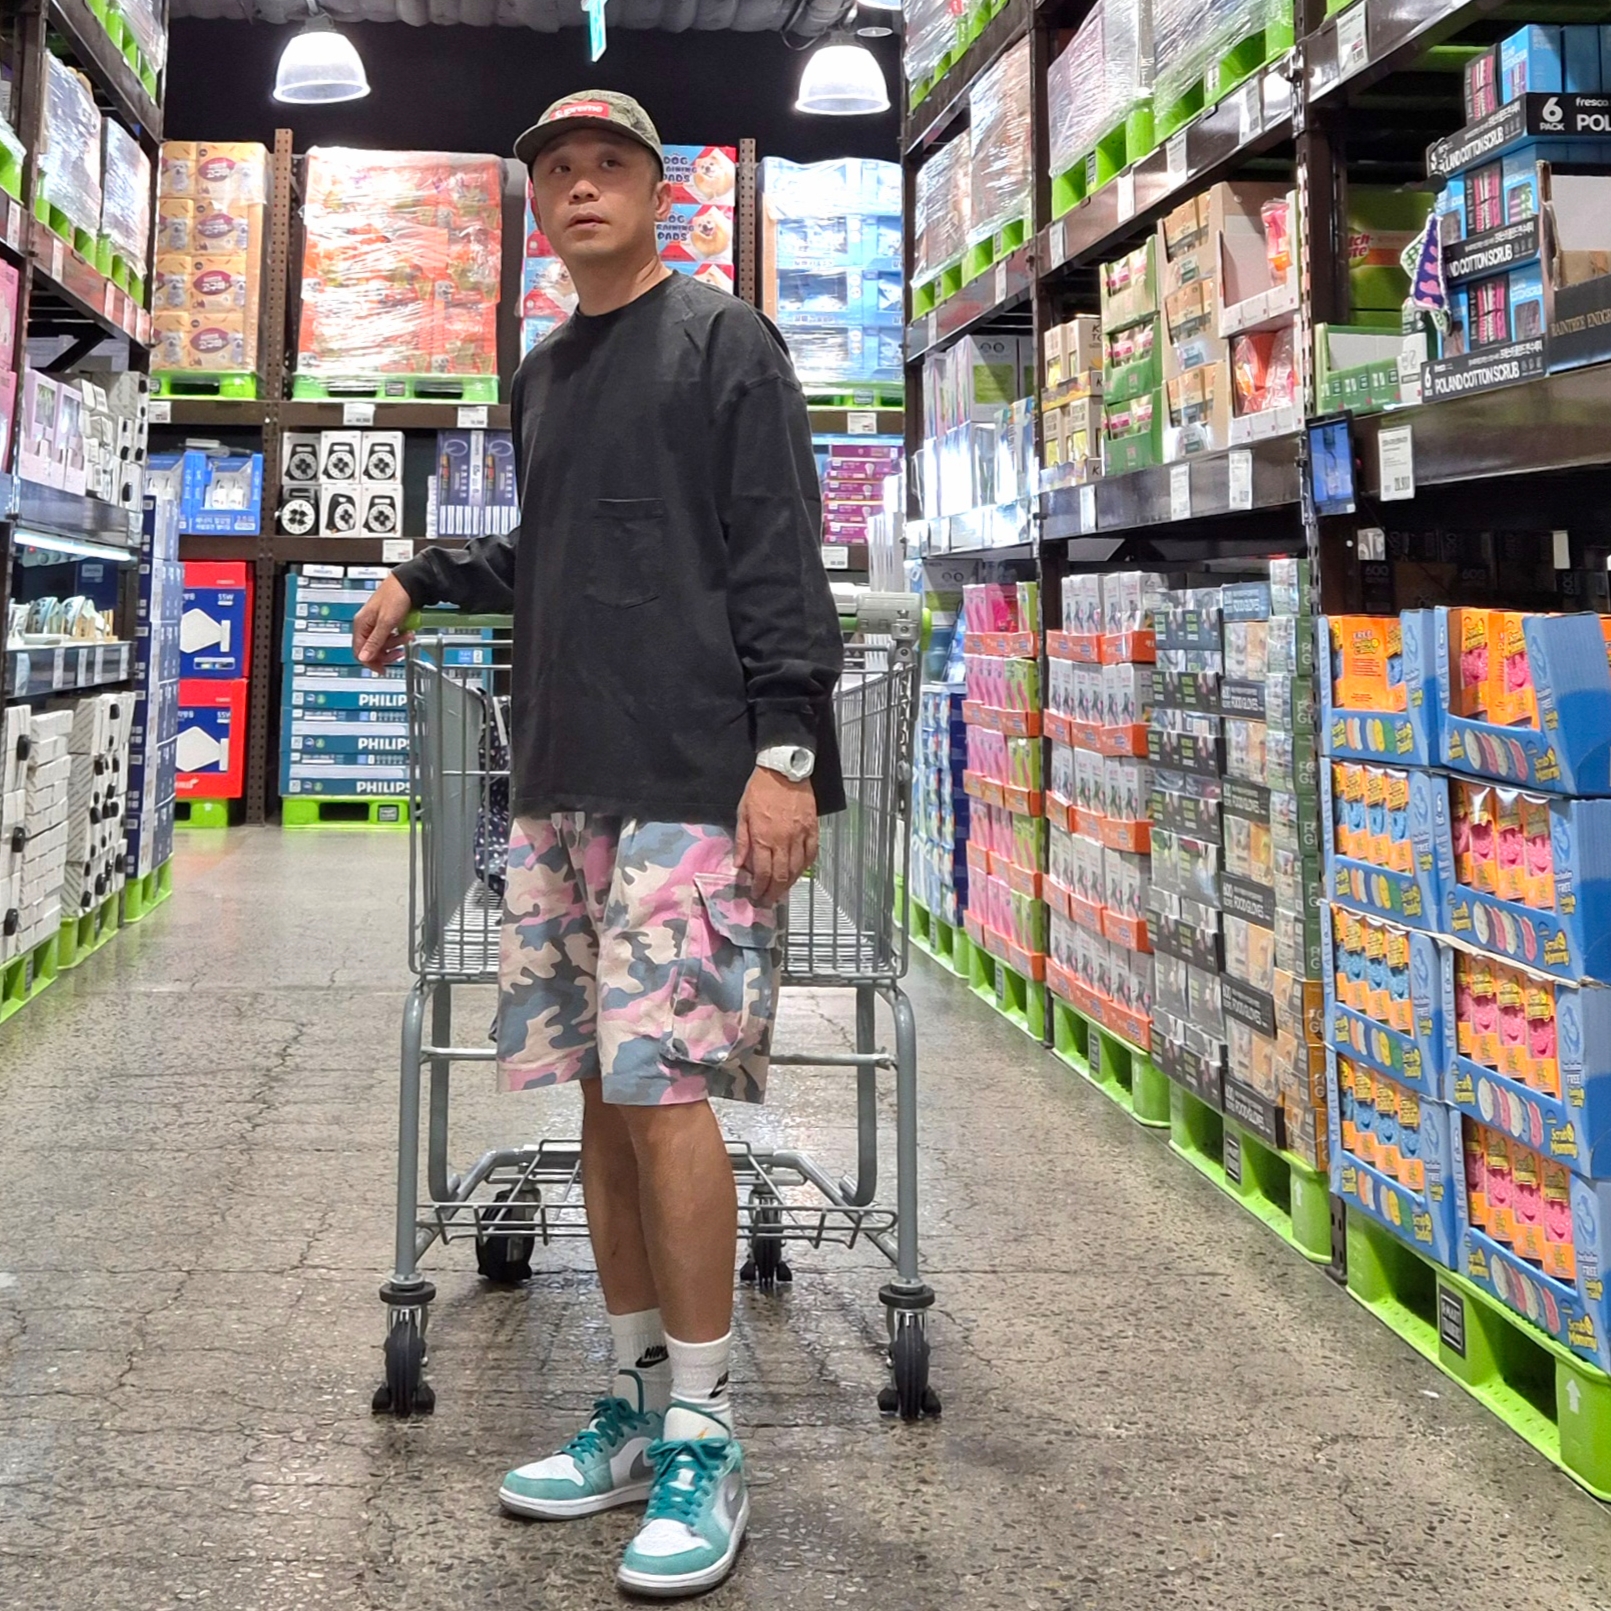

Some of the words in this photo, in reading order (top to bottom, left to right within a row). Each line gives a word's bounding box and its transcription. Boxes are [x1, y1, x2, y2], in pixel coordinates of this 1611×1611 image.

[555, 104, 604, 119] Spreme
[1542, 97, 1563, 122] 6
[1540, 122, 1565, 131] PACK
[663, 156, 688, 165] DOG
[668, 215, 685, 223] OG
[657, 232, 688, 241] PADS
[359, 693, 408, 707] PHILIP
[1582, 1265, 1598, 1277] FREE
